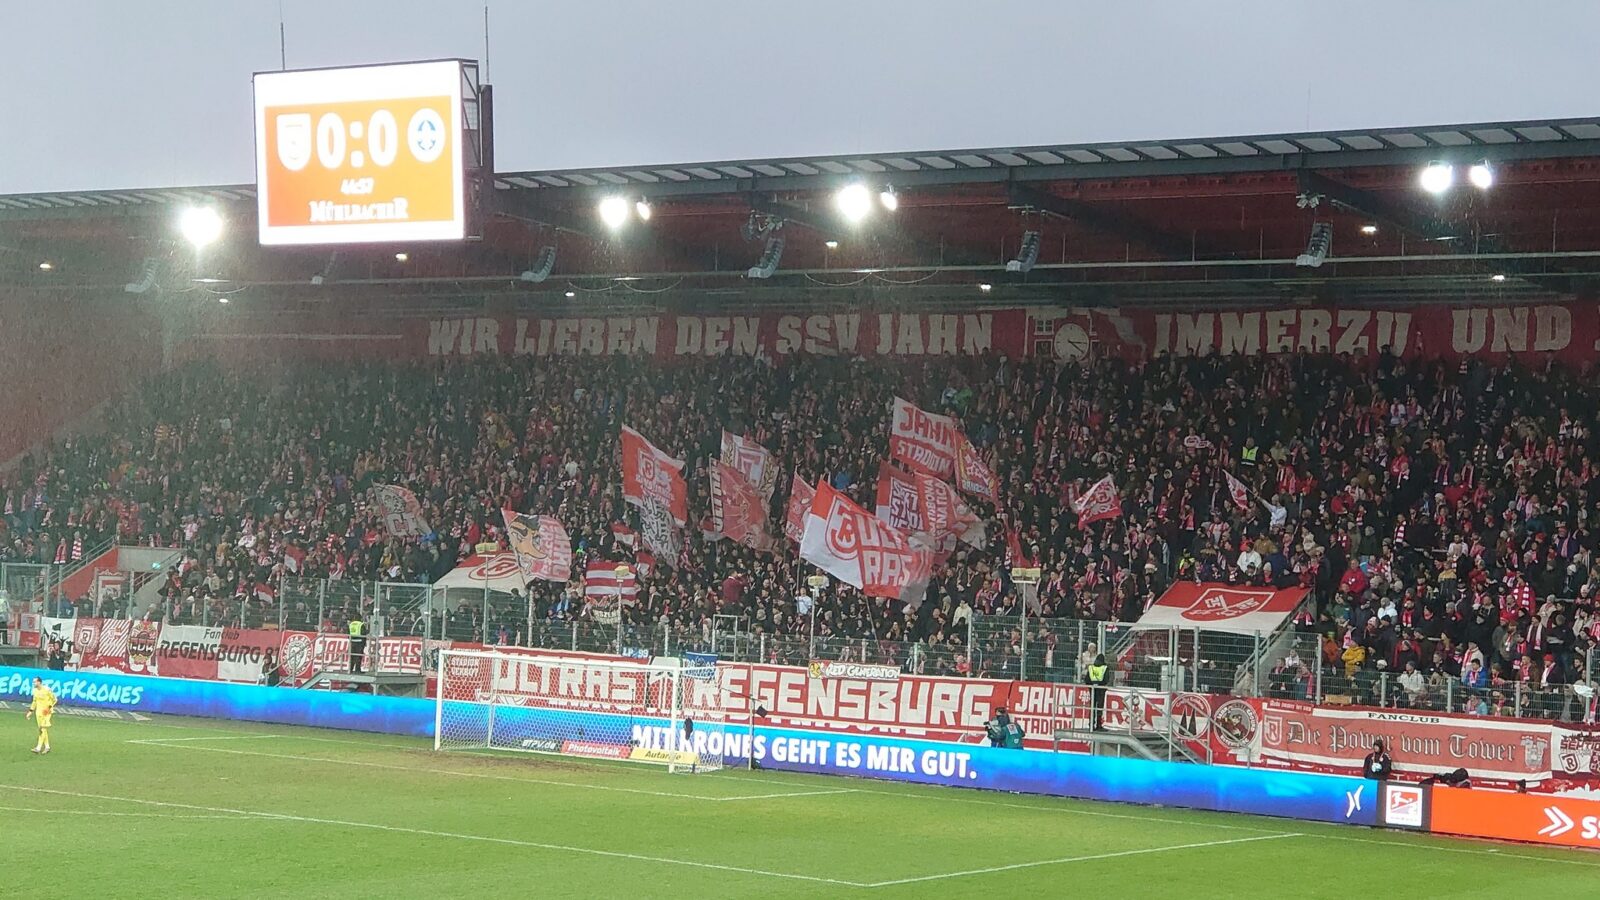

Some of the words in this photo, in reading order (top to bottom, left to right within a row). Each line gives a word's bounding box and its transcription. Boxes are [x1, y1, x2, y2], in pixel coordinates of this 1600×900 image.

[316, 108, 398, 170] 0:0
[428, 318, 499, 355] WIR
[514, 317, 659, 356] LIEBEN
[675, 316, 760, 356] DEN
[776, 313, 861, 357] SSV
[876, 313, 993, 356] JAHN
[1153, 308, 1412, 358] IMMERZU
[1451, 305, 1572, 354] UND
[159, 640, 261, 665] REGENSBURG
[318, 640, 349, 662] JAH
[491, 653, 637, 701] ULTRAS
[693, 667, 994, 727] REGENSBURG
[1014, 686, 1074, 716] JAHN
[1367, 712, 1440, 724] FANCLUB
[633, 724, 677, 751] MIT
[678, 731, 767, 760] KRONES
[771, 737, 831, 766] GEHT
[836, 742, 862, 769] ES
[867, 745, 916, 774] MIR
[921, 750, 978, 780] GUT.
[644, 750, 682, 761] Autarie
[1287, 720, 1321, 746] Die
[1400, 731, 1442, 755] vom
[1449, 733, 1517, 762] Tower
